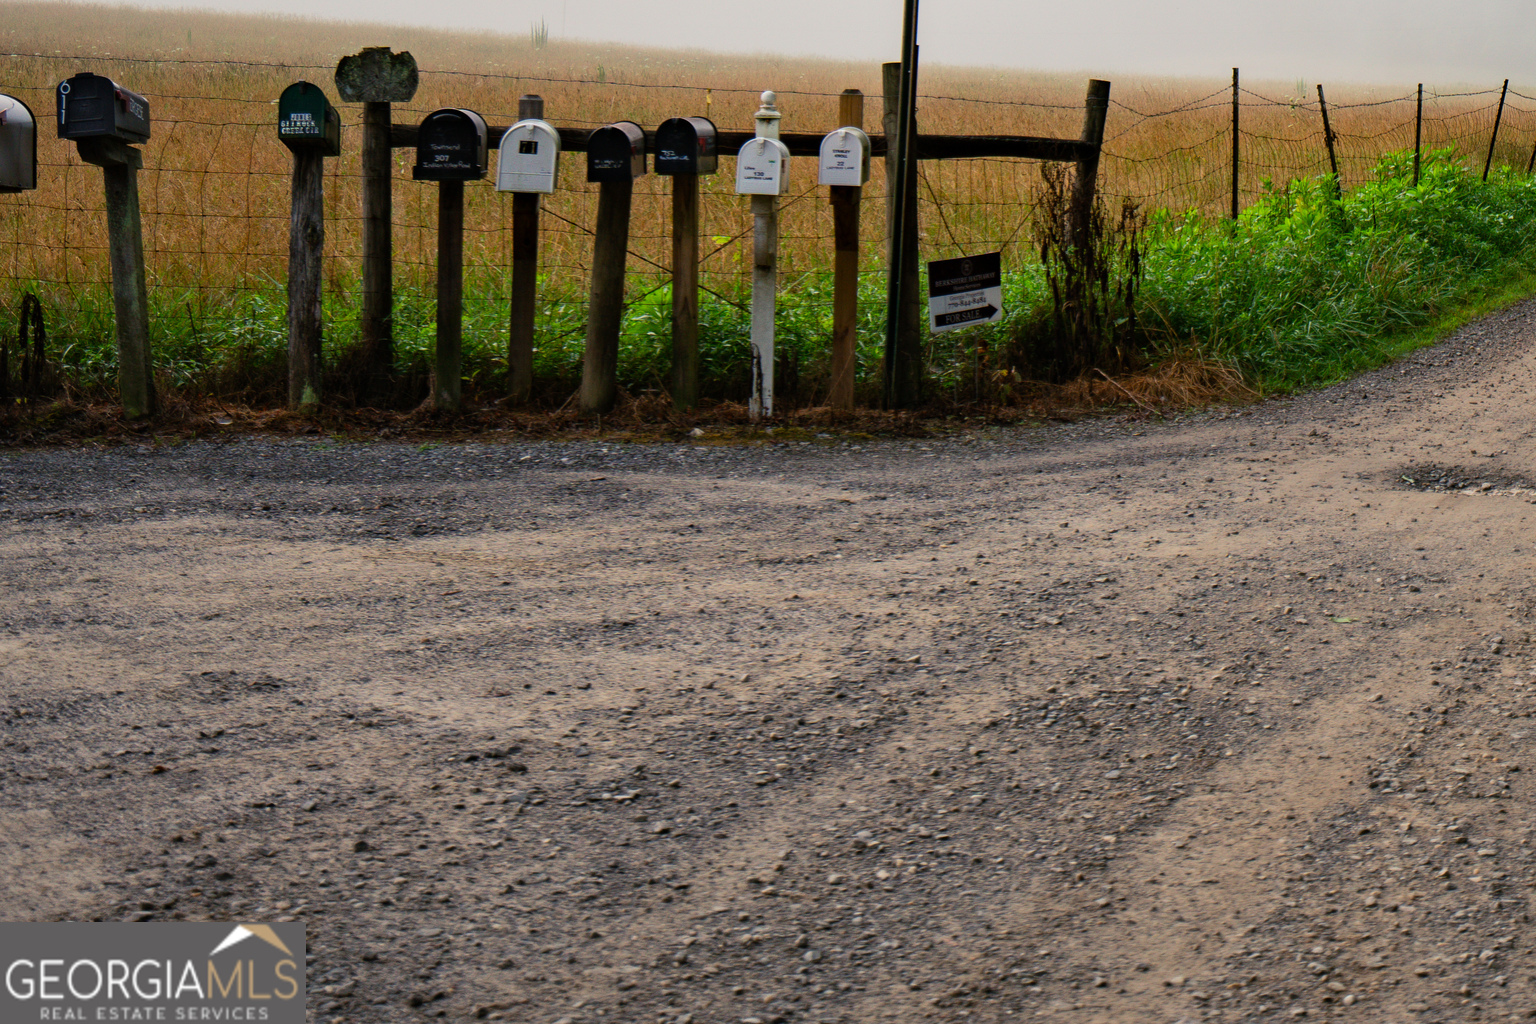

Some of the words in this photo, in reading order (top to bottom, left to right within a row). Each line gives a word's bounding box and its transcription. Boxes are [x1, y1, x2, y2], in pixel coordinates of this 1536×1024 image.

[59, 79, 71, 125] 611
[434, 154, 450, 162] 307
[935, 276, 968, 287] BERKSHIRE
[968, 272, 995, 282] HATHAWAY
[945, 312, 962, 324] FOR
[962, 309, 981, 321] SALE
